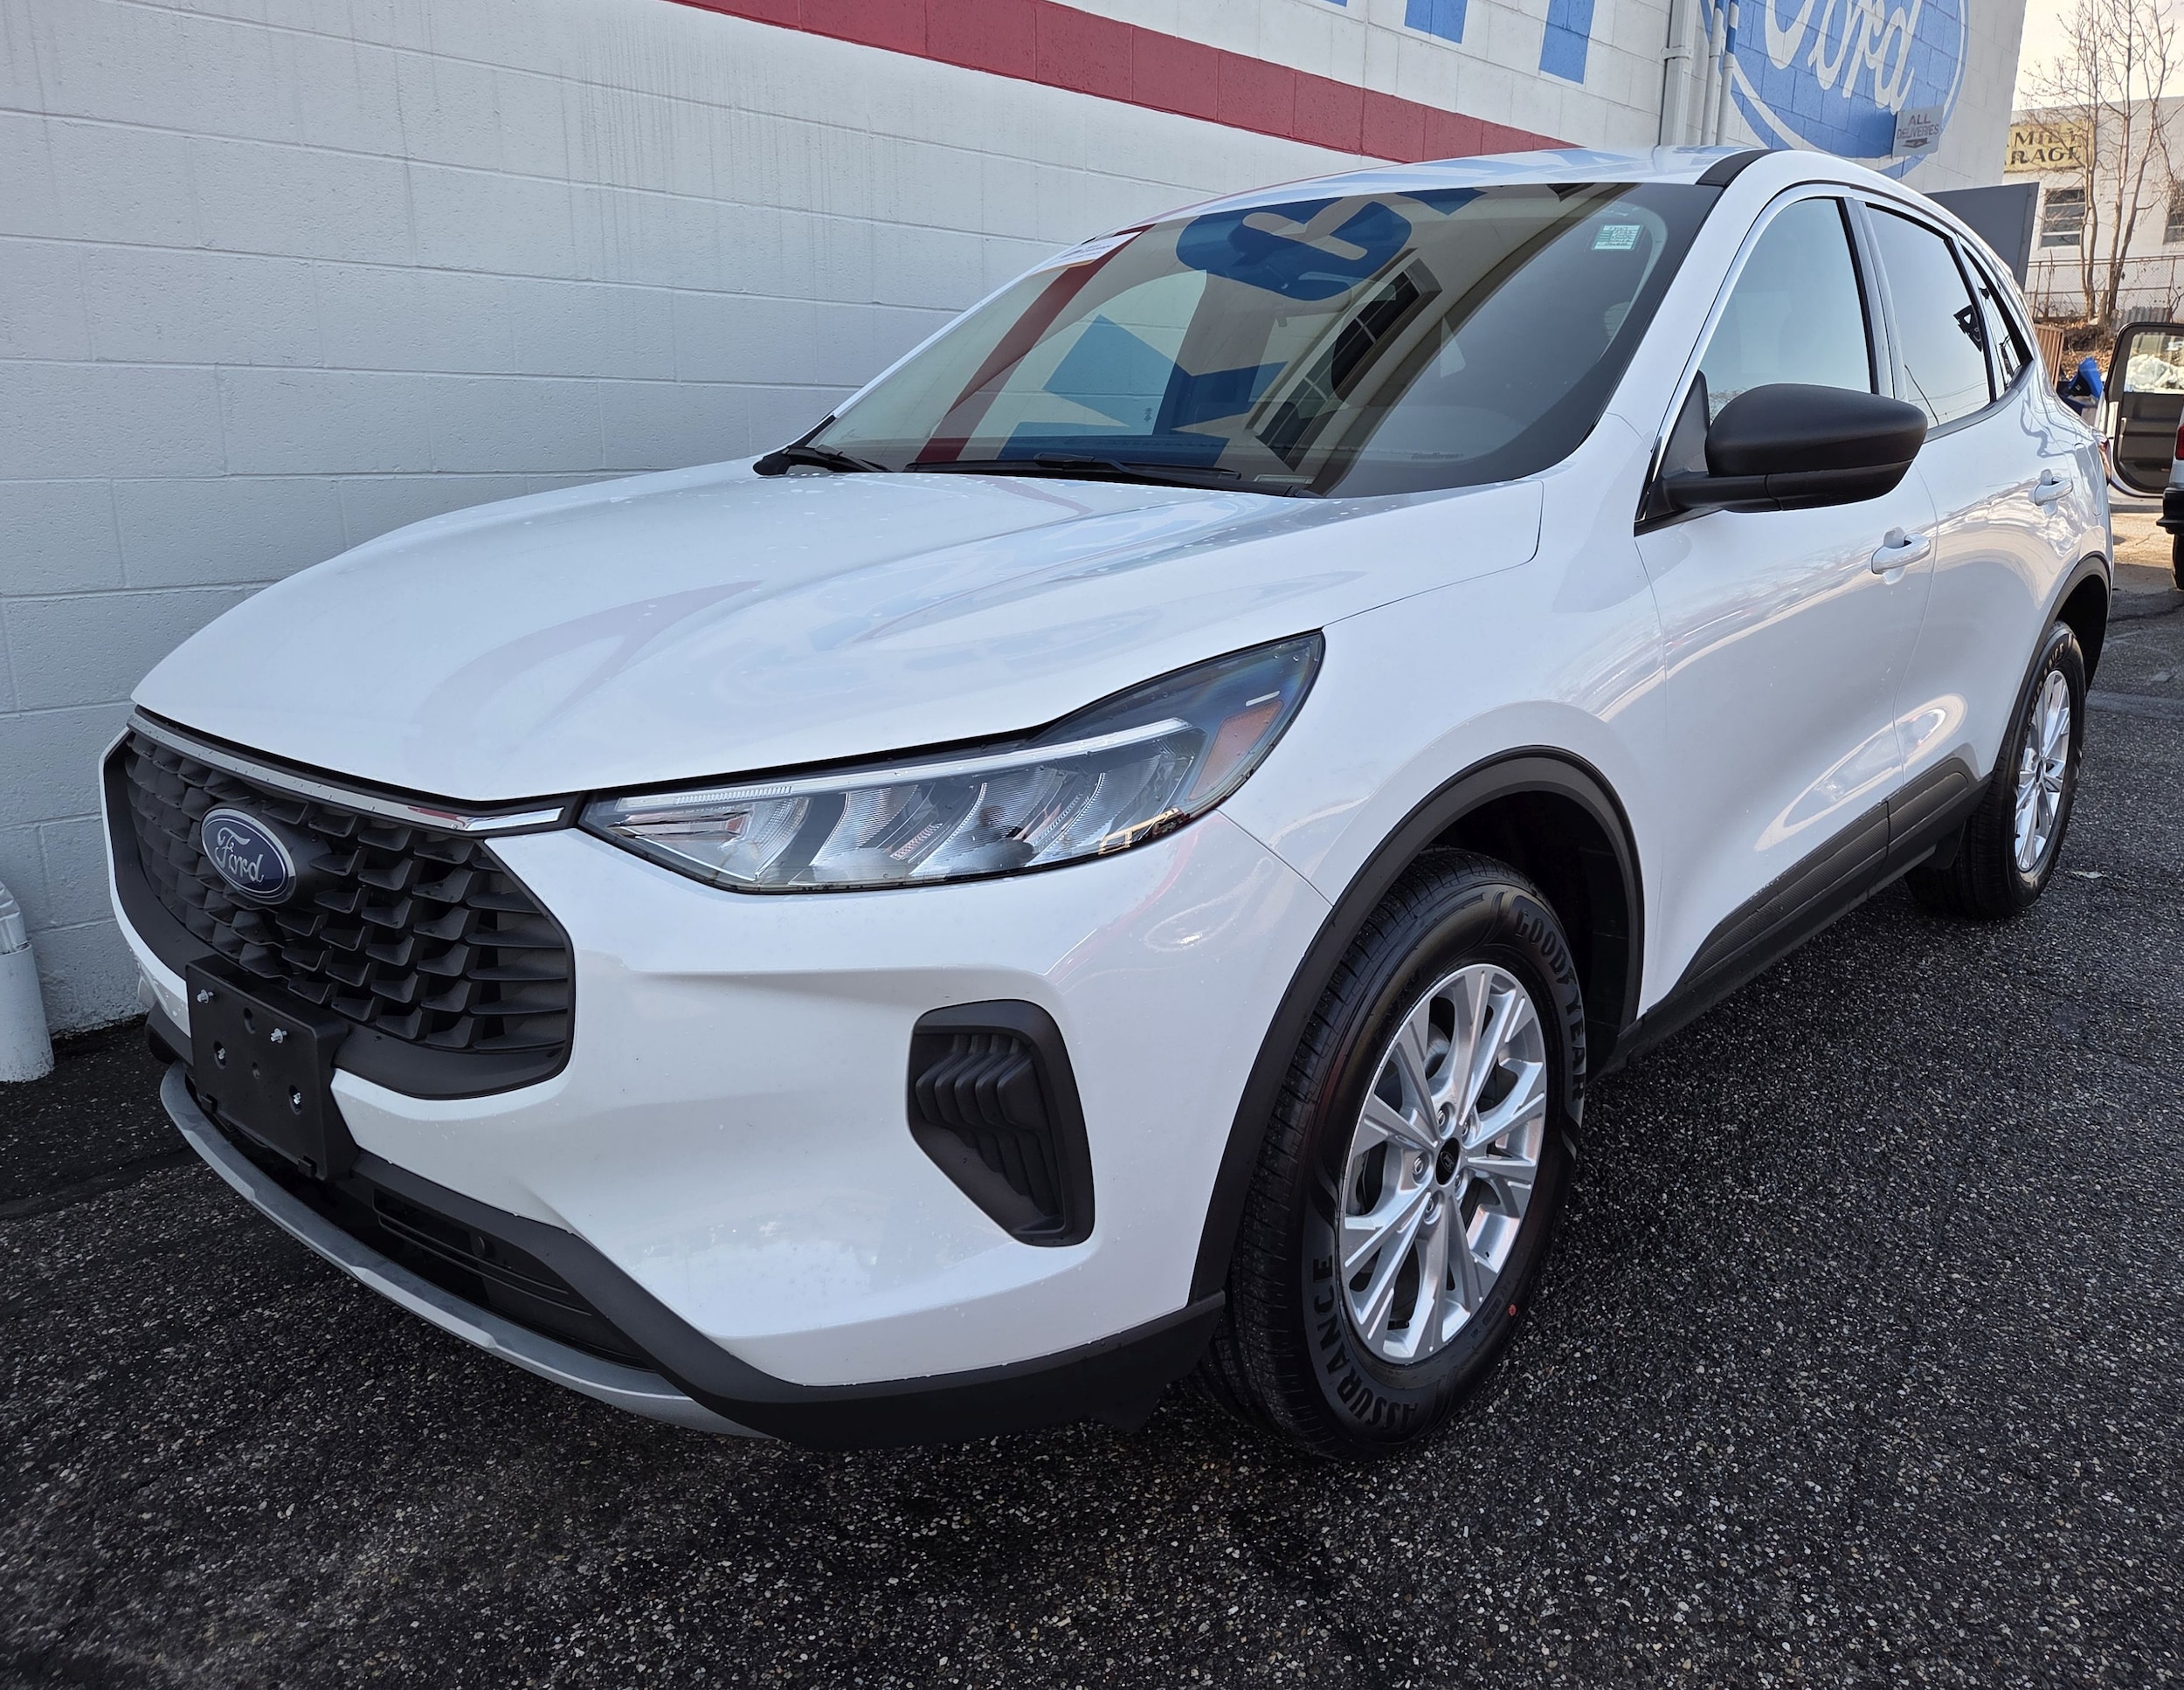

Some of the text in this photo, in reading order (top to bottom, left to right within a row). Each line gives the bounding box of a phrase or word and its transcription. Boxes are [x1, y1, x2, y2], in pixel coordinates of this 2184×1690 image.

[1897, 124, 1939, 140] DELIVERIES
[1908, 113, 1932, 126] ALL
[214, 826, 265, 883] Ford
[1514, 907, 1586, 1101] GOODYEAR
[1312, 1255, 1418, 1432] ASSURANCE
